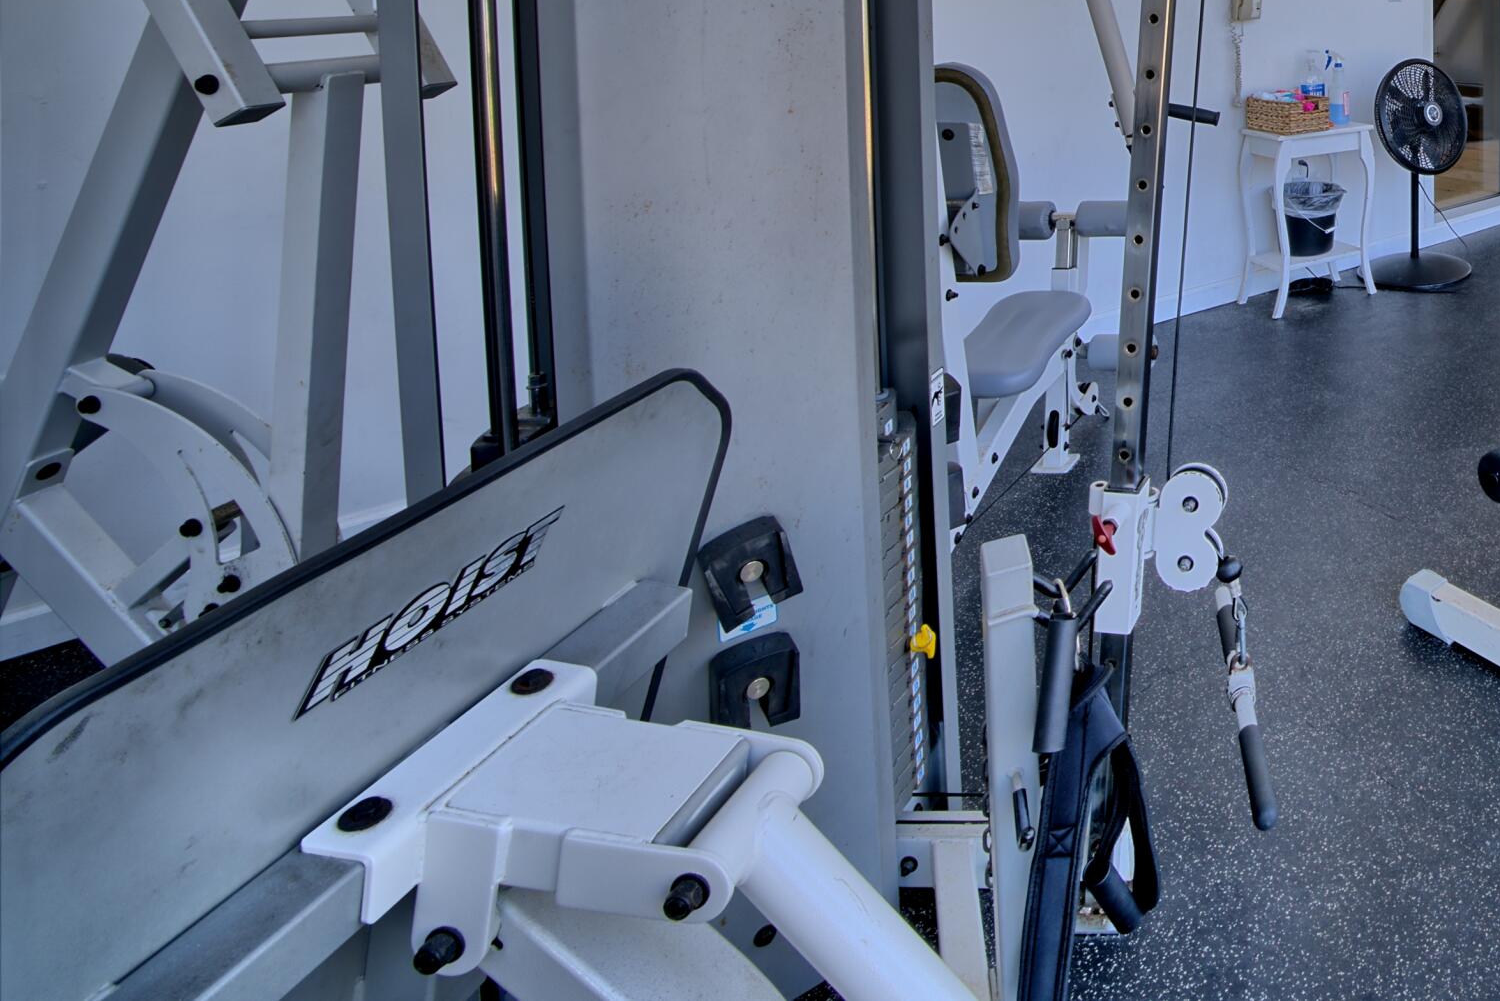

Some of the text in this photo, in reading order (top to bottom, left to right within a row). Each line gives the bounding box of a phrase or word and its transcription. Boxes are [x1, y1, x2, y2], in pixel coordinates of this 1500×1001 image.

[291, 505, 566, 722] HOIST
[333, 560, 535, 701] FITNESS SYSTEMS
